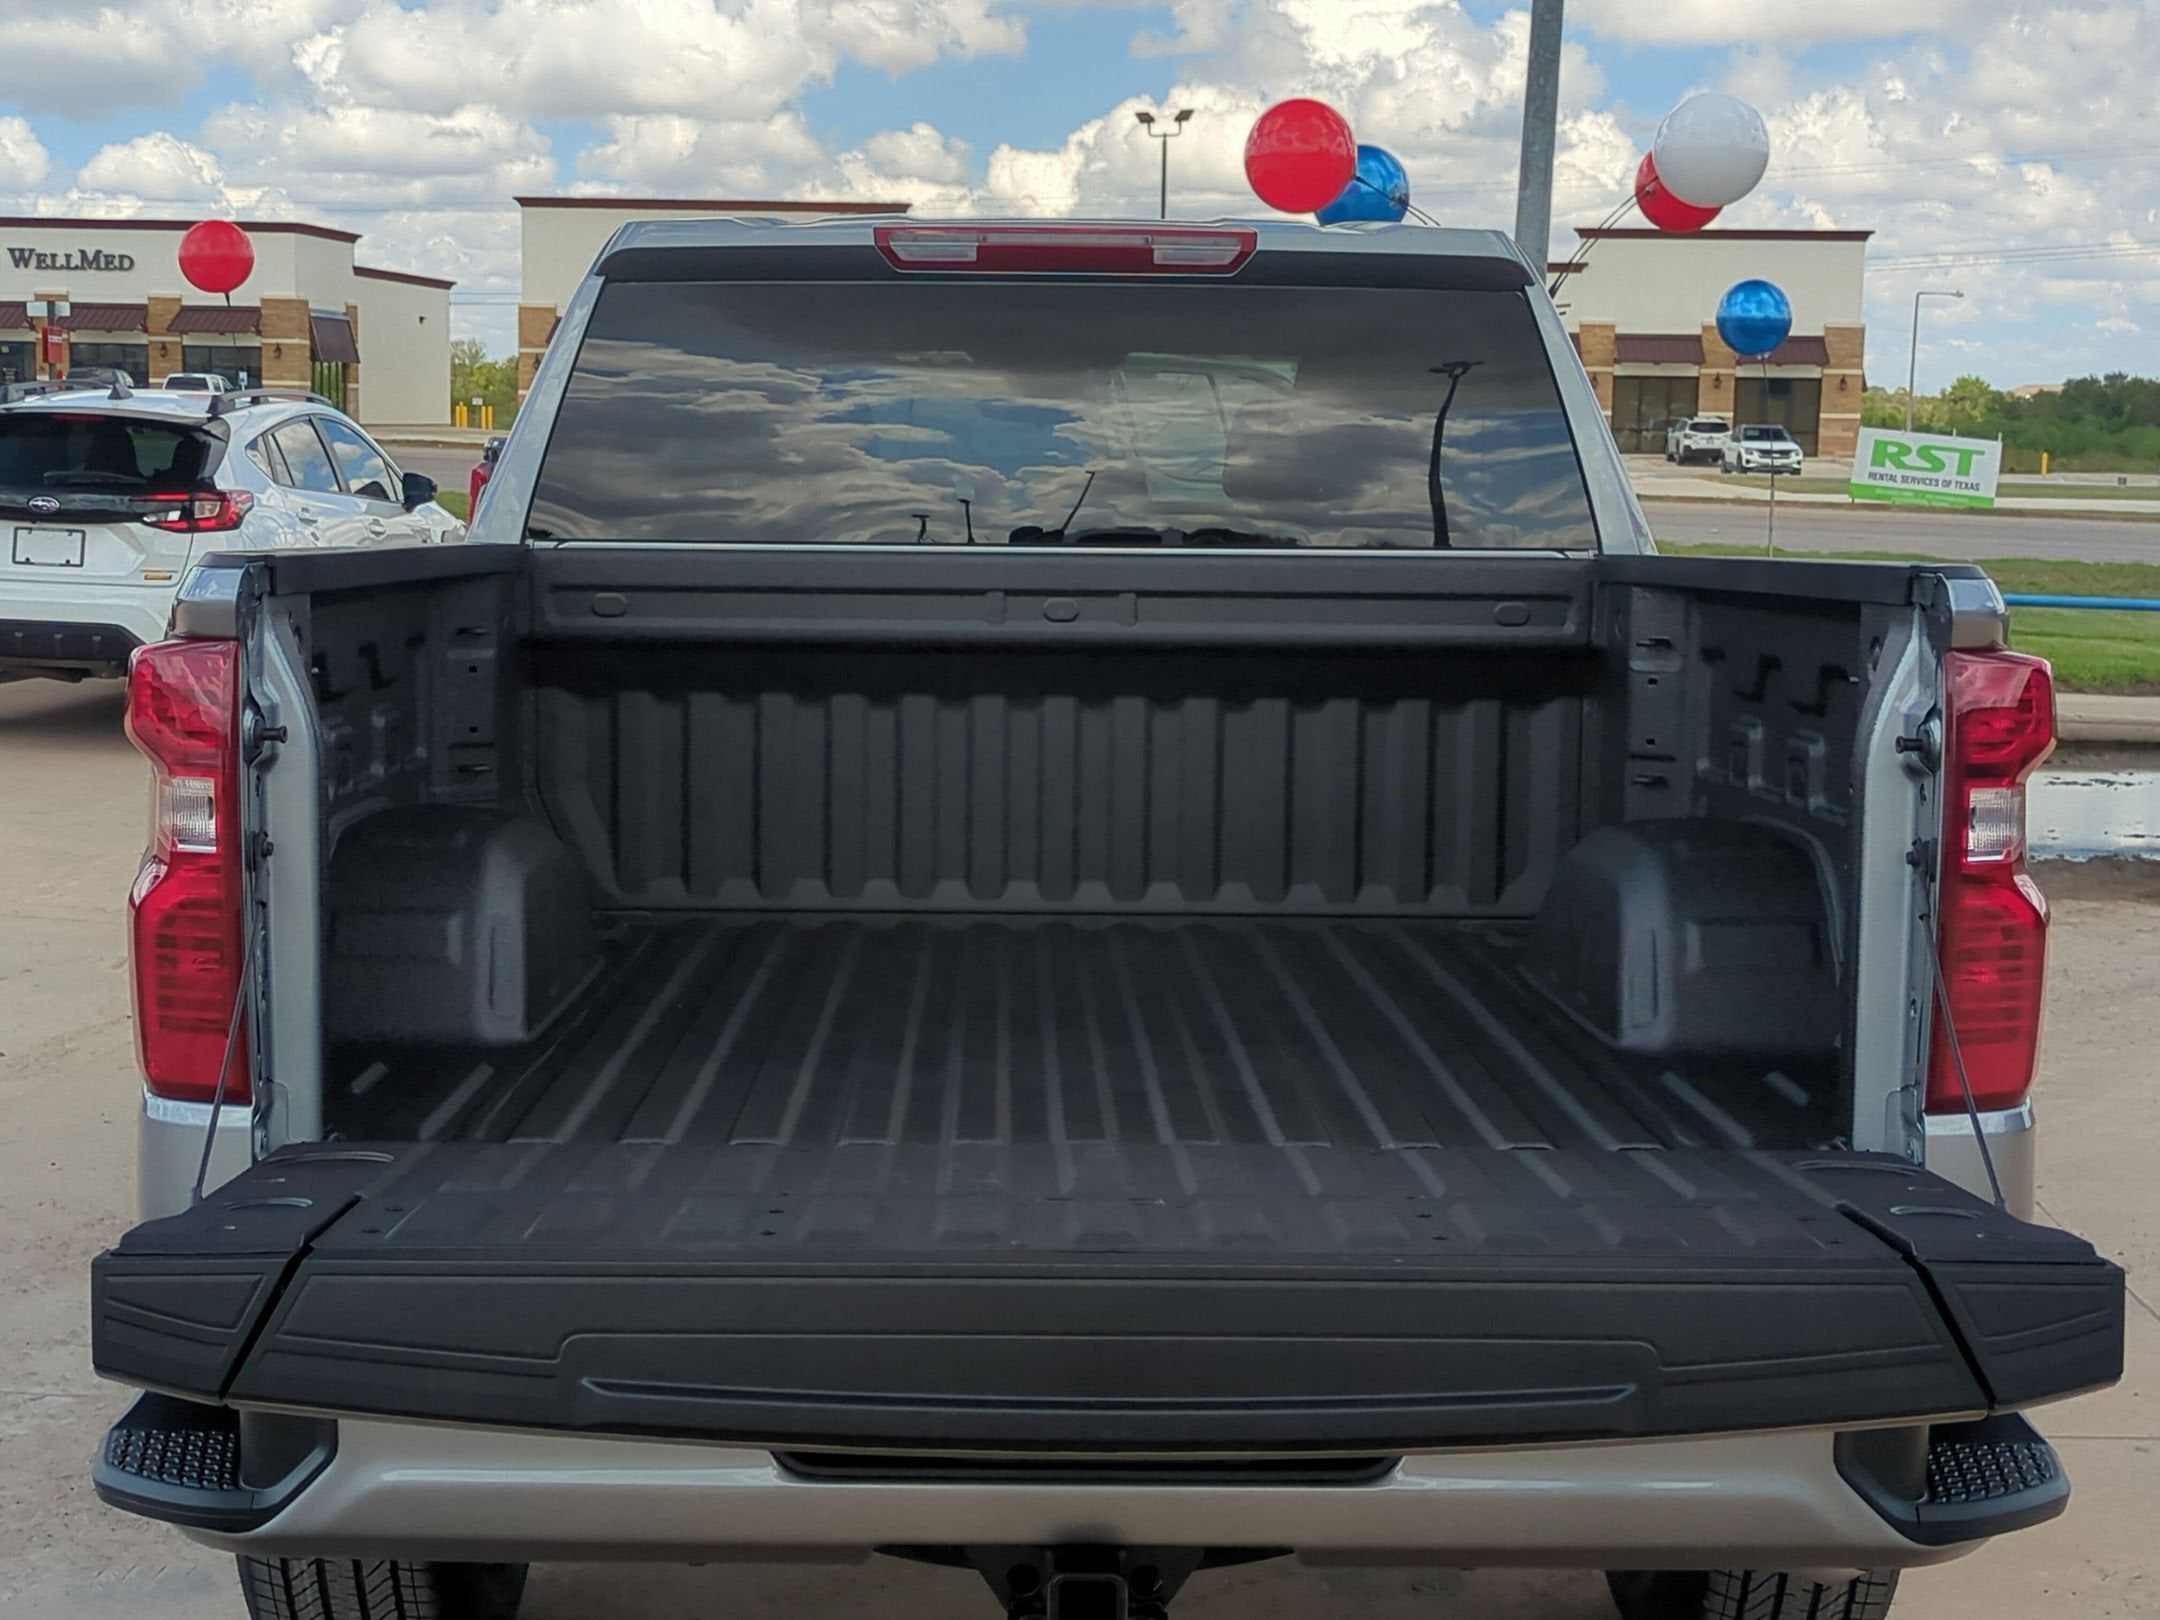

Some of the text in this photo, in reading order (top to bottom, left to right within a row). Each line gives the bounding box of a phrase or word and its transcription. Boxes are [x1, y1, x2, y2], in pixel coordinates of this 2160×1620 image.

[1870, 438, 1985, 477] RST
[1868, 471, 1981, 492] RENTAL SERVICES OF TEXAS
